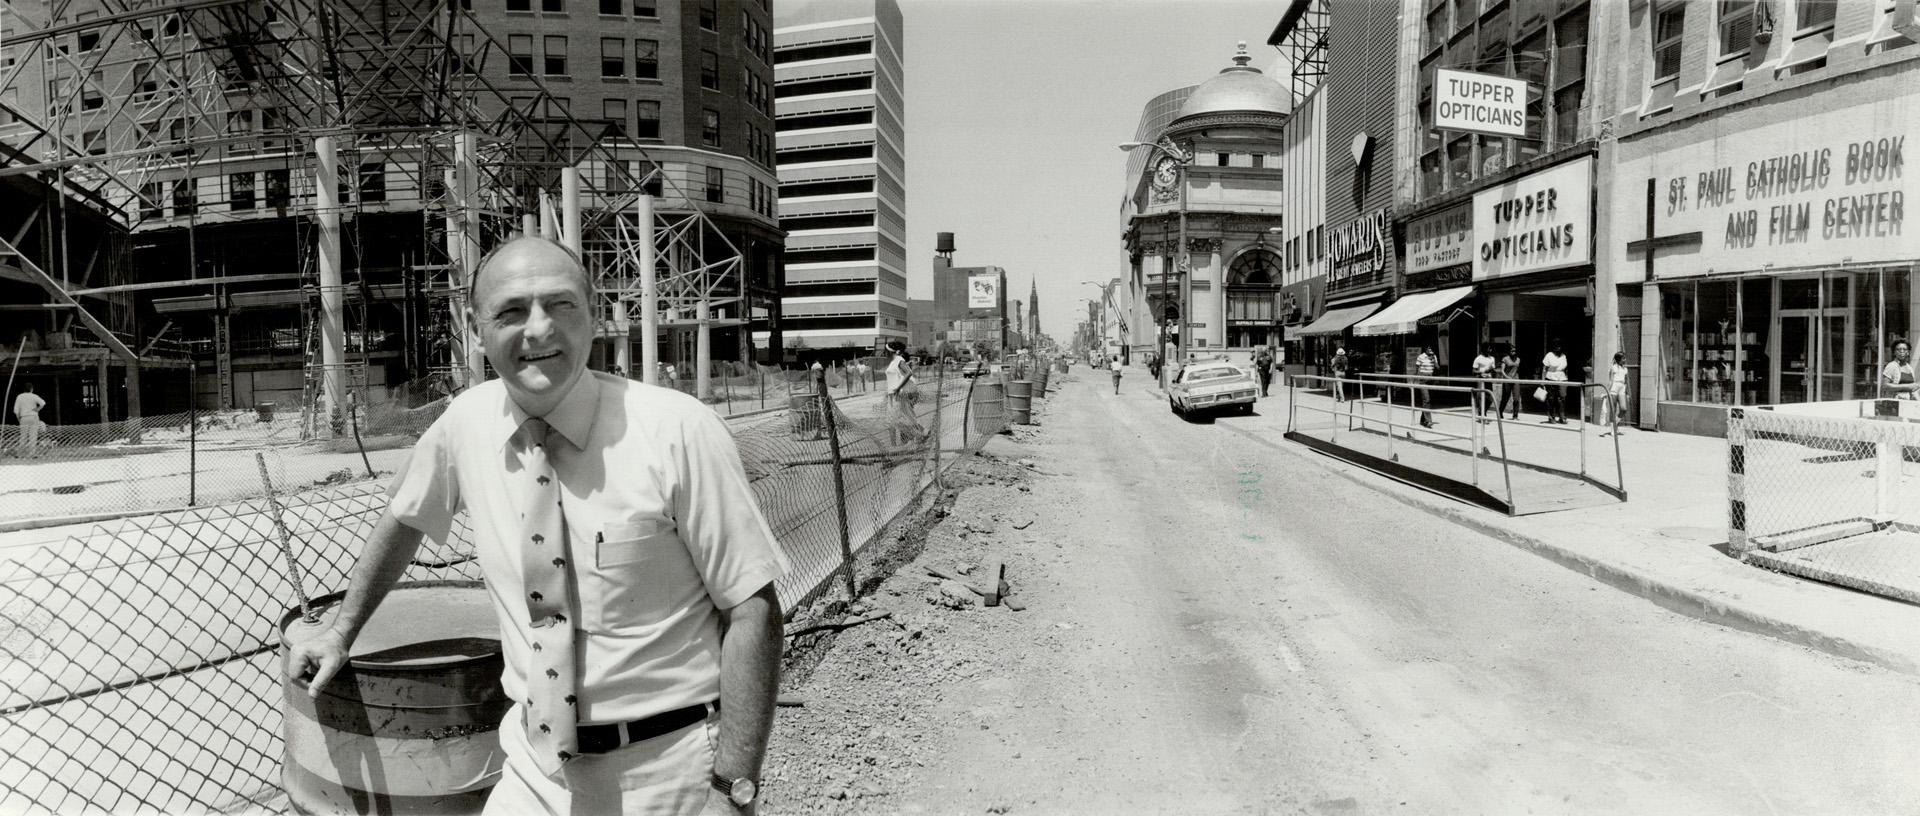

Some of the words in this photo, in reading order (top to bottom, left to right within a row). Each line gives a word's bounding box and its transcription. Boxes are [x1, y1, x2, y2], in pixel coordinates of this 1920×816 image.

[1449, 78, 1514, 104] TUPPER
[1440, 101, 1523, 127] OPTICIANS
[1668, 177, 1687, 211] ST.
[1698, 166, 1736, 205] PAUL
[1747, 148, 1831, 194] CATHOLIC
[1847, 135, 1904, 181] BOOK
[1493, 187, 1557, 224] TUPPER
[1726, 210, 1758, 245] AND
[1770, 202, 1810, 241] FILM
[1824, 190, 1904, 235] CENTER
[1481, 223, 1574, 262] OPTICIANS
